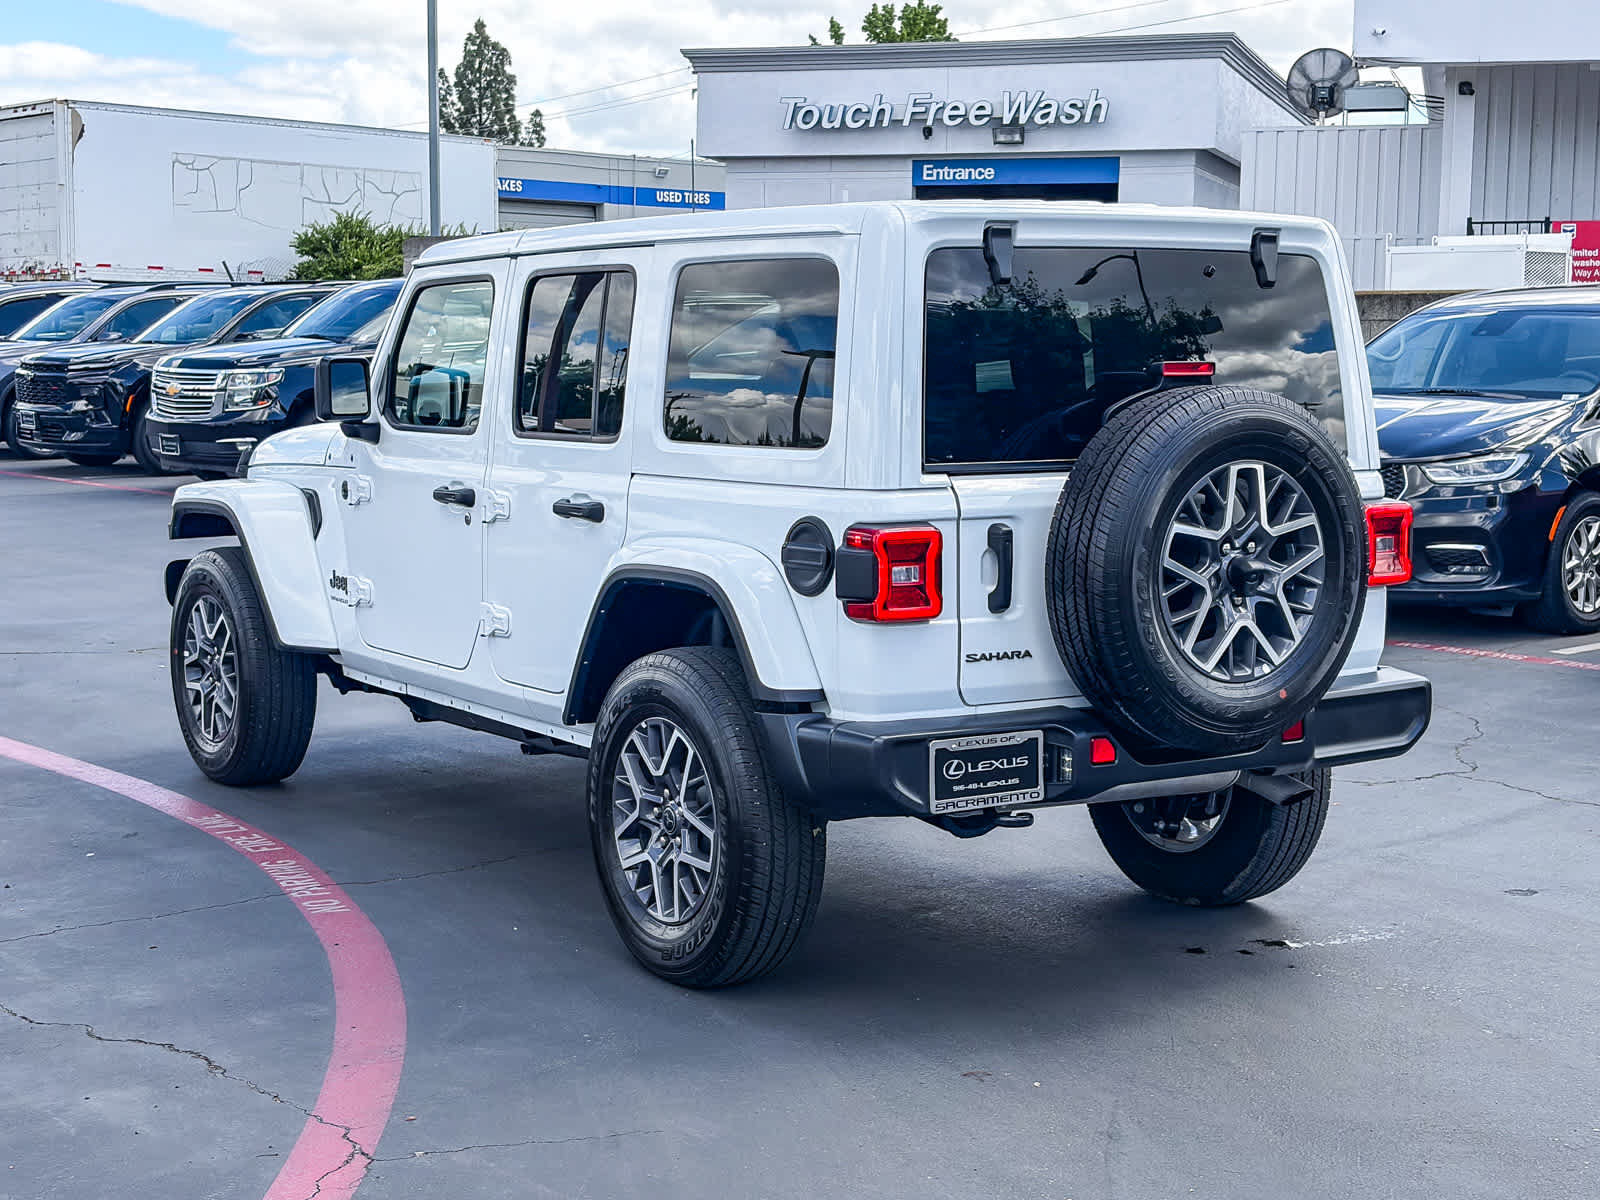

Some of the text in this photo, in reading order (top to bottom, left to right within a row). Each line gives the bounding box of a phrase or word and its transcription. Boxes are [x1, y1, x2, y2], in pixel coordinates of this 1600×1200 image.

[780, 88, 1110, 130] Touch Free Wash
[922, 164, 996, 181] Entrance
[656, 190, 711, 205] USED TIRES
[1574, 269, 1592, 278] Way
[330, 569, 348, 595] Jeep
[965, 649, 1033, 663] SAHARA
[957, 735, 1016, 748] LEXUS OF
[968, 756, 1029, 773] LEXUS
[935, 791, 1041, 812] SACRAMENTO
[223, 833, 285, 853] FIRE
[260, 859, 332, 897] PARKING
[301, 898, 351, 914] NO
